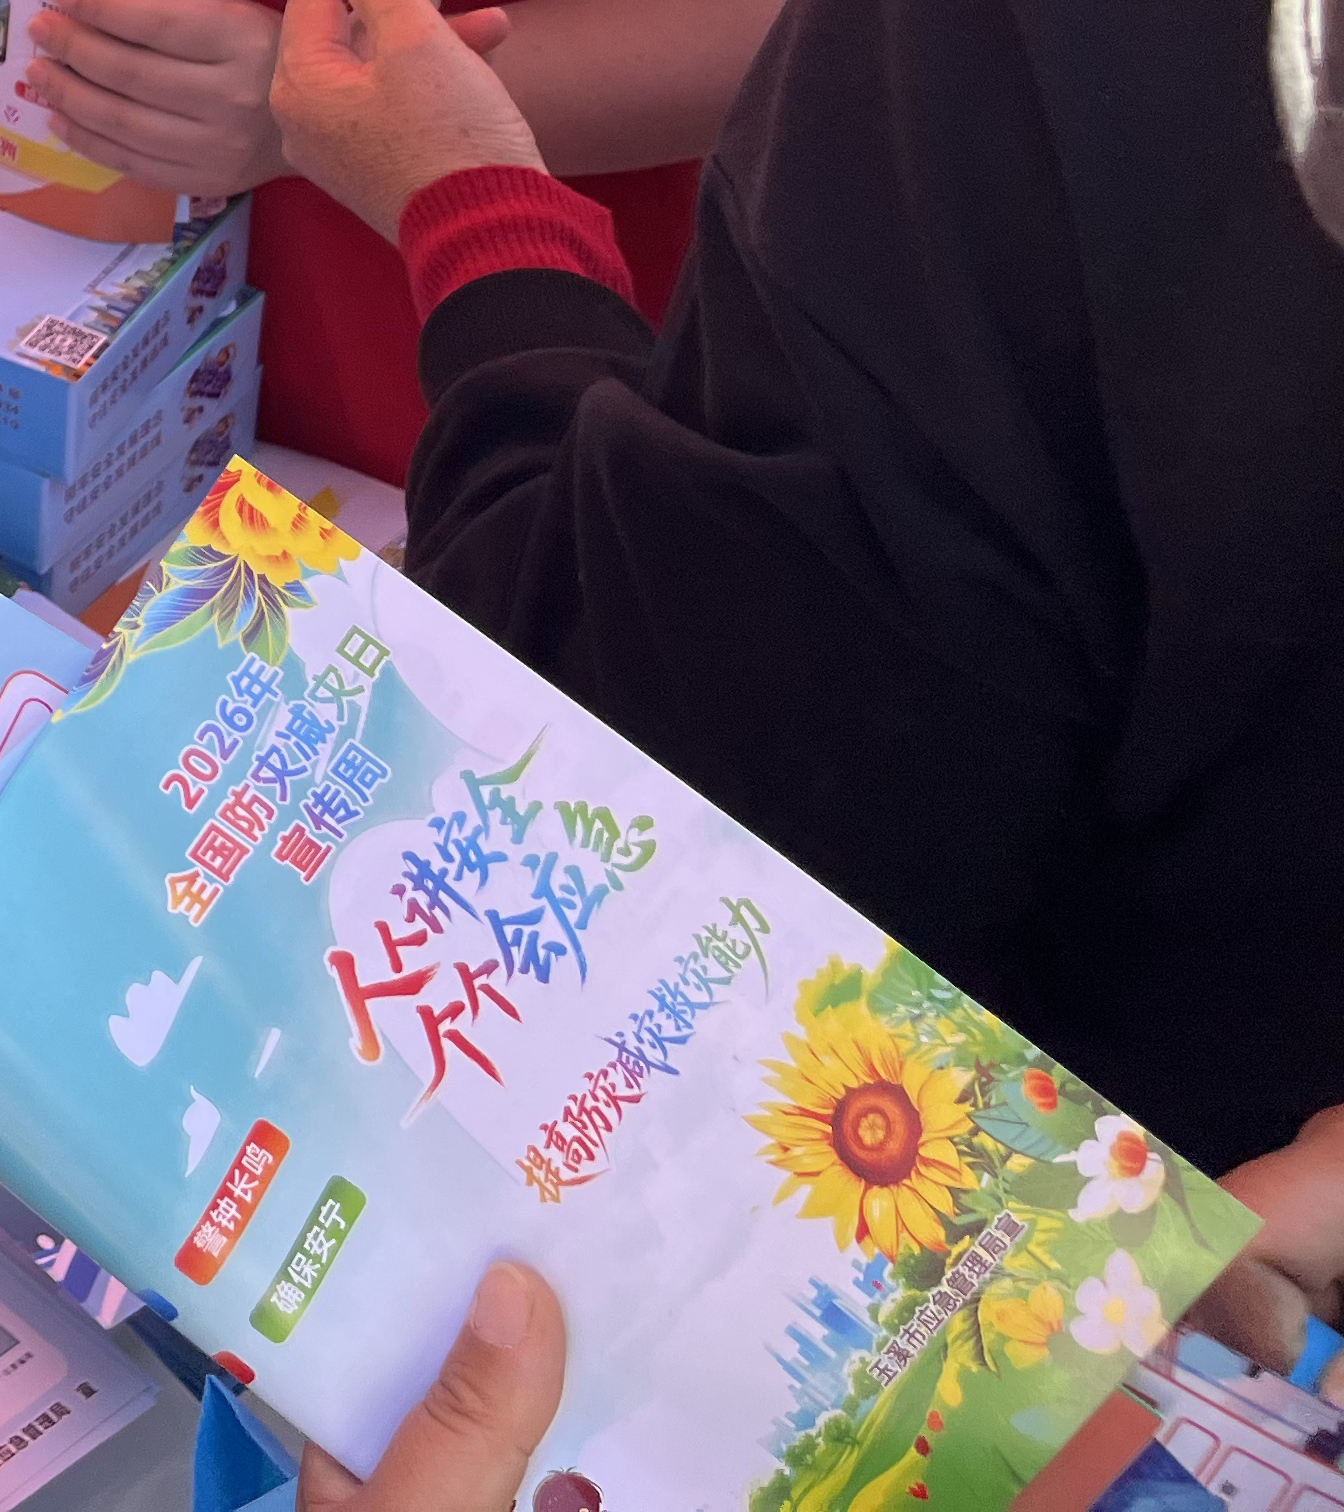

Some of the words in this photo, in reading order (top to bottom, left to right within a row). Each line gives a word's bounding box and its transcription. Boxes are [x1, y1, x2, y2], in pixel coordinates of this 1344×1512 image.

[162, 654, 283, 812] 2026年
[166, 624, 390, 925] 全国防灾减灾日
[273, 740, 392, 883] 宣传周
[328, 724, 549, 1062] 人人讲安全
[401, 799, 657, 1128] 个个会应急
[515, 896, 771, 1204] 提高防灾减灾救灾能力
[192, 1143, 275, 1258] 警钟长鸣
[269, 1197, 349, 1317] 确保安宁
